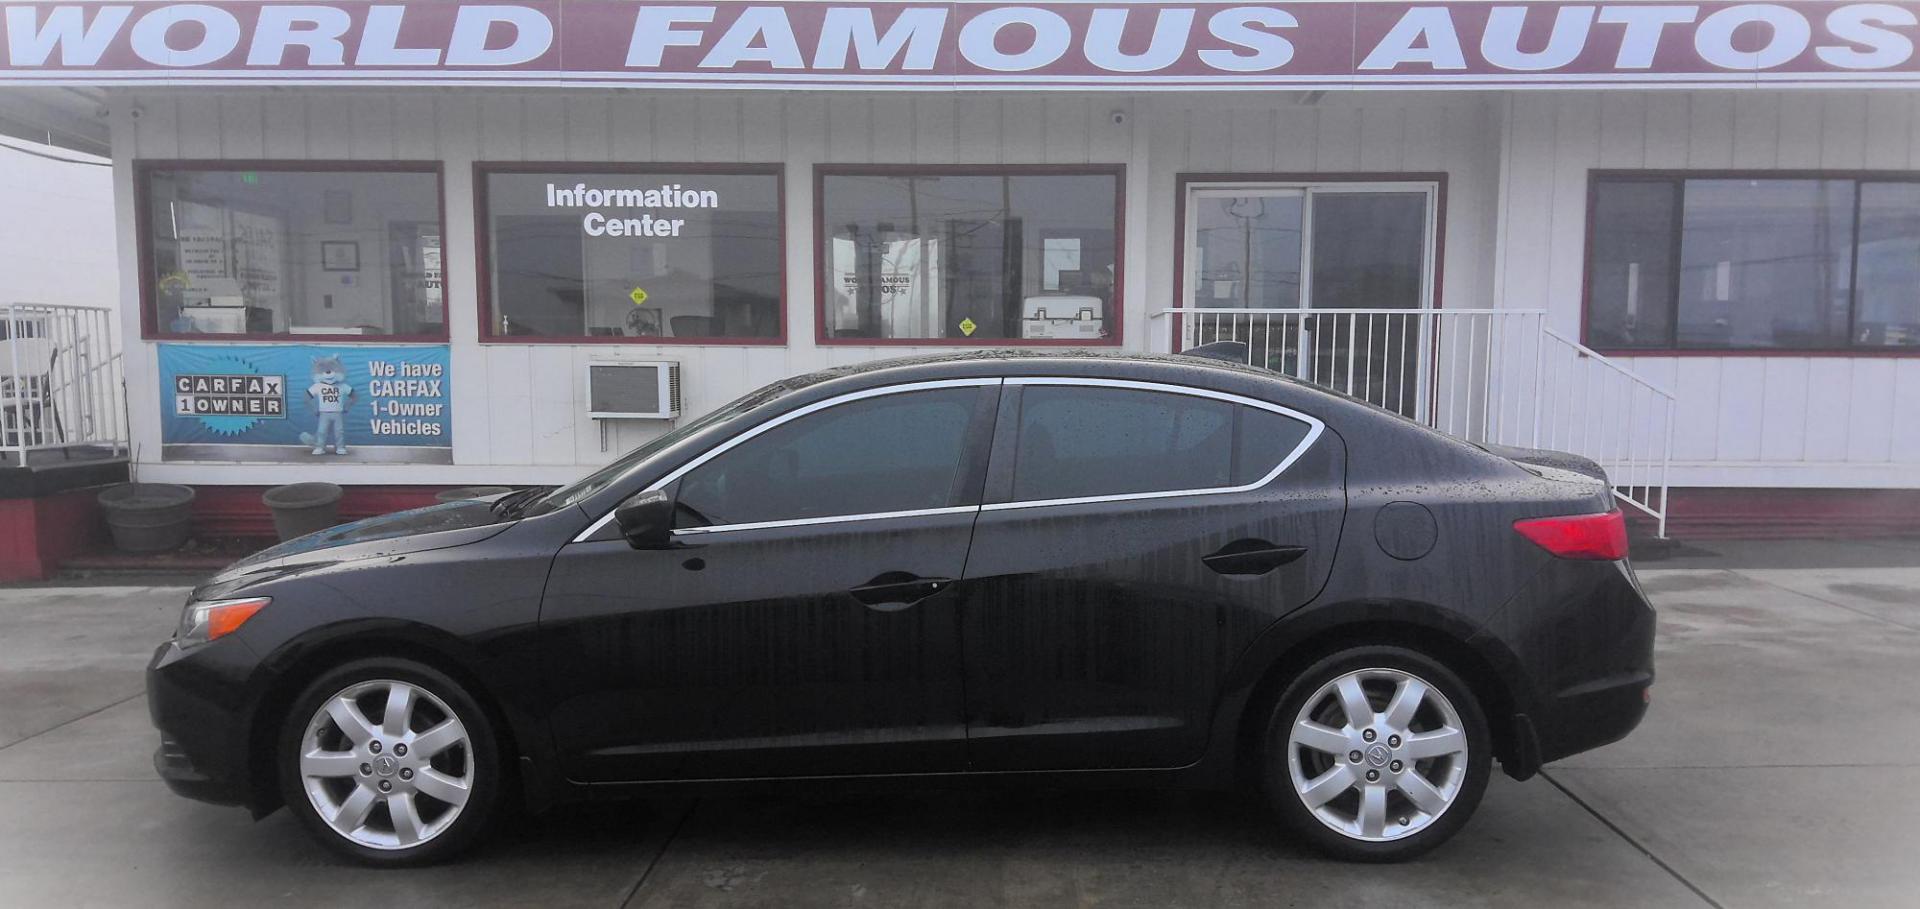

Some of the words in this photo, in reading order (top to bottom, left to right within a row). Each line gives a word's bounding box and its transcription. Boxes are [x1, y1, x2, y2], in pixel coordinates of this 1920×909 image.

[5, 4, 553, 67] WORLD
[624, 5, 1299, 72] FAMOUS
[1356, 3, 1918, 71] AUTOS
[546, 183, 718, 208] Information
[583, 212, 685, 237] Center
[368, 360, 395, 377] We
[400, 361, 442, 377] have
[178, 377, 279, 395] CARFAX
[321, 387, 340, 395] CAR
[369, 379, 441, 397] CARFAX
[181, 398, 191, 412] 1
[197, 399, 279, 413] OWNER
[322, 395, 339, 403] FOX
[370, 400, 443, 416] 1-Owner
[370, 418, 441, 435] Vehicles
